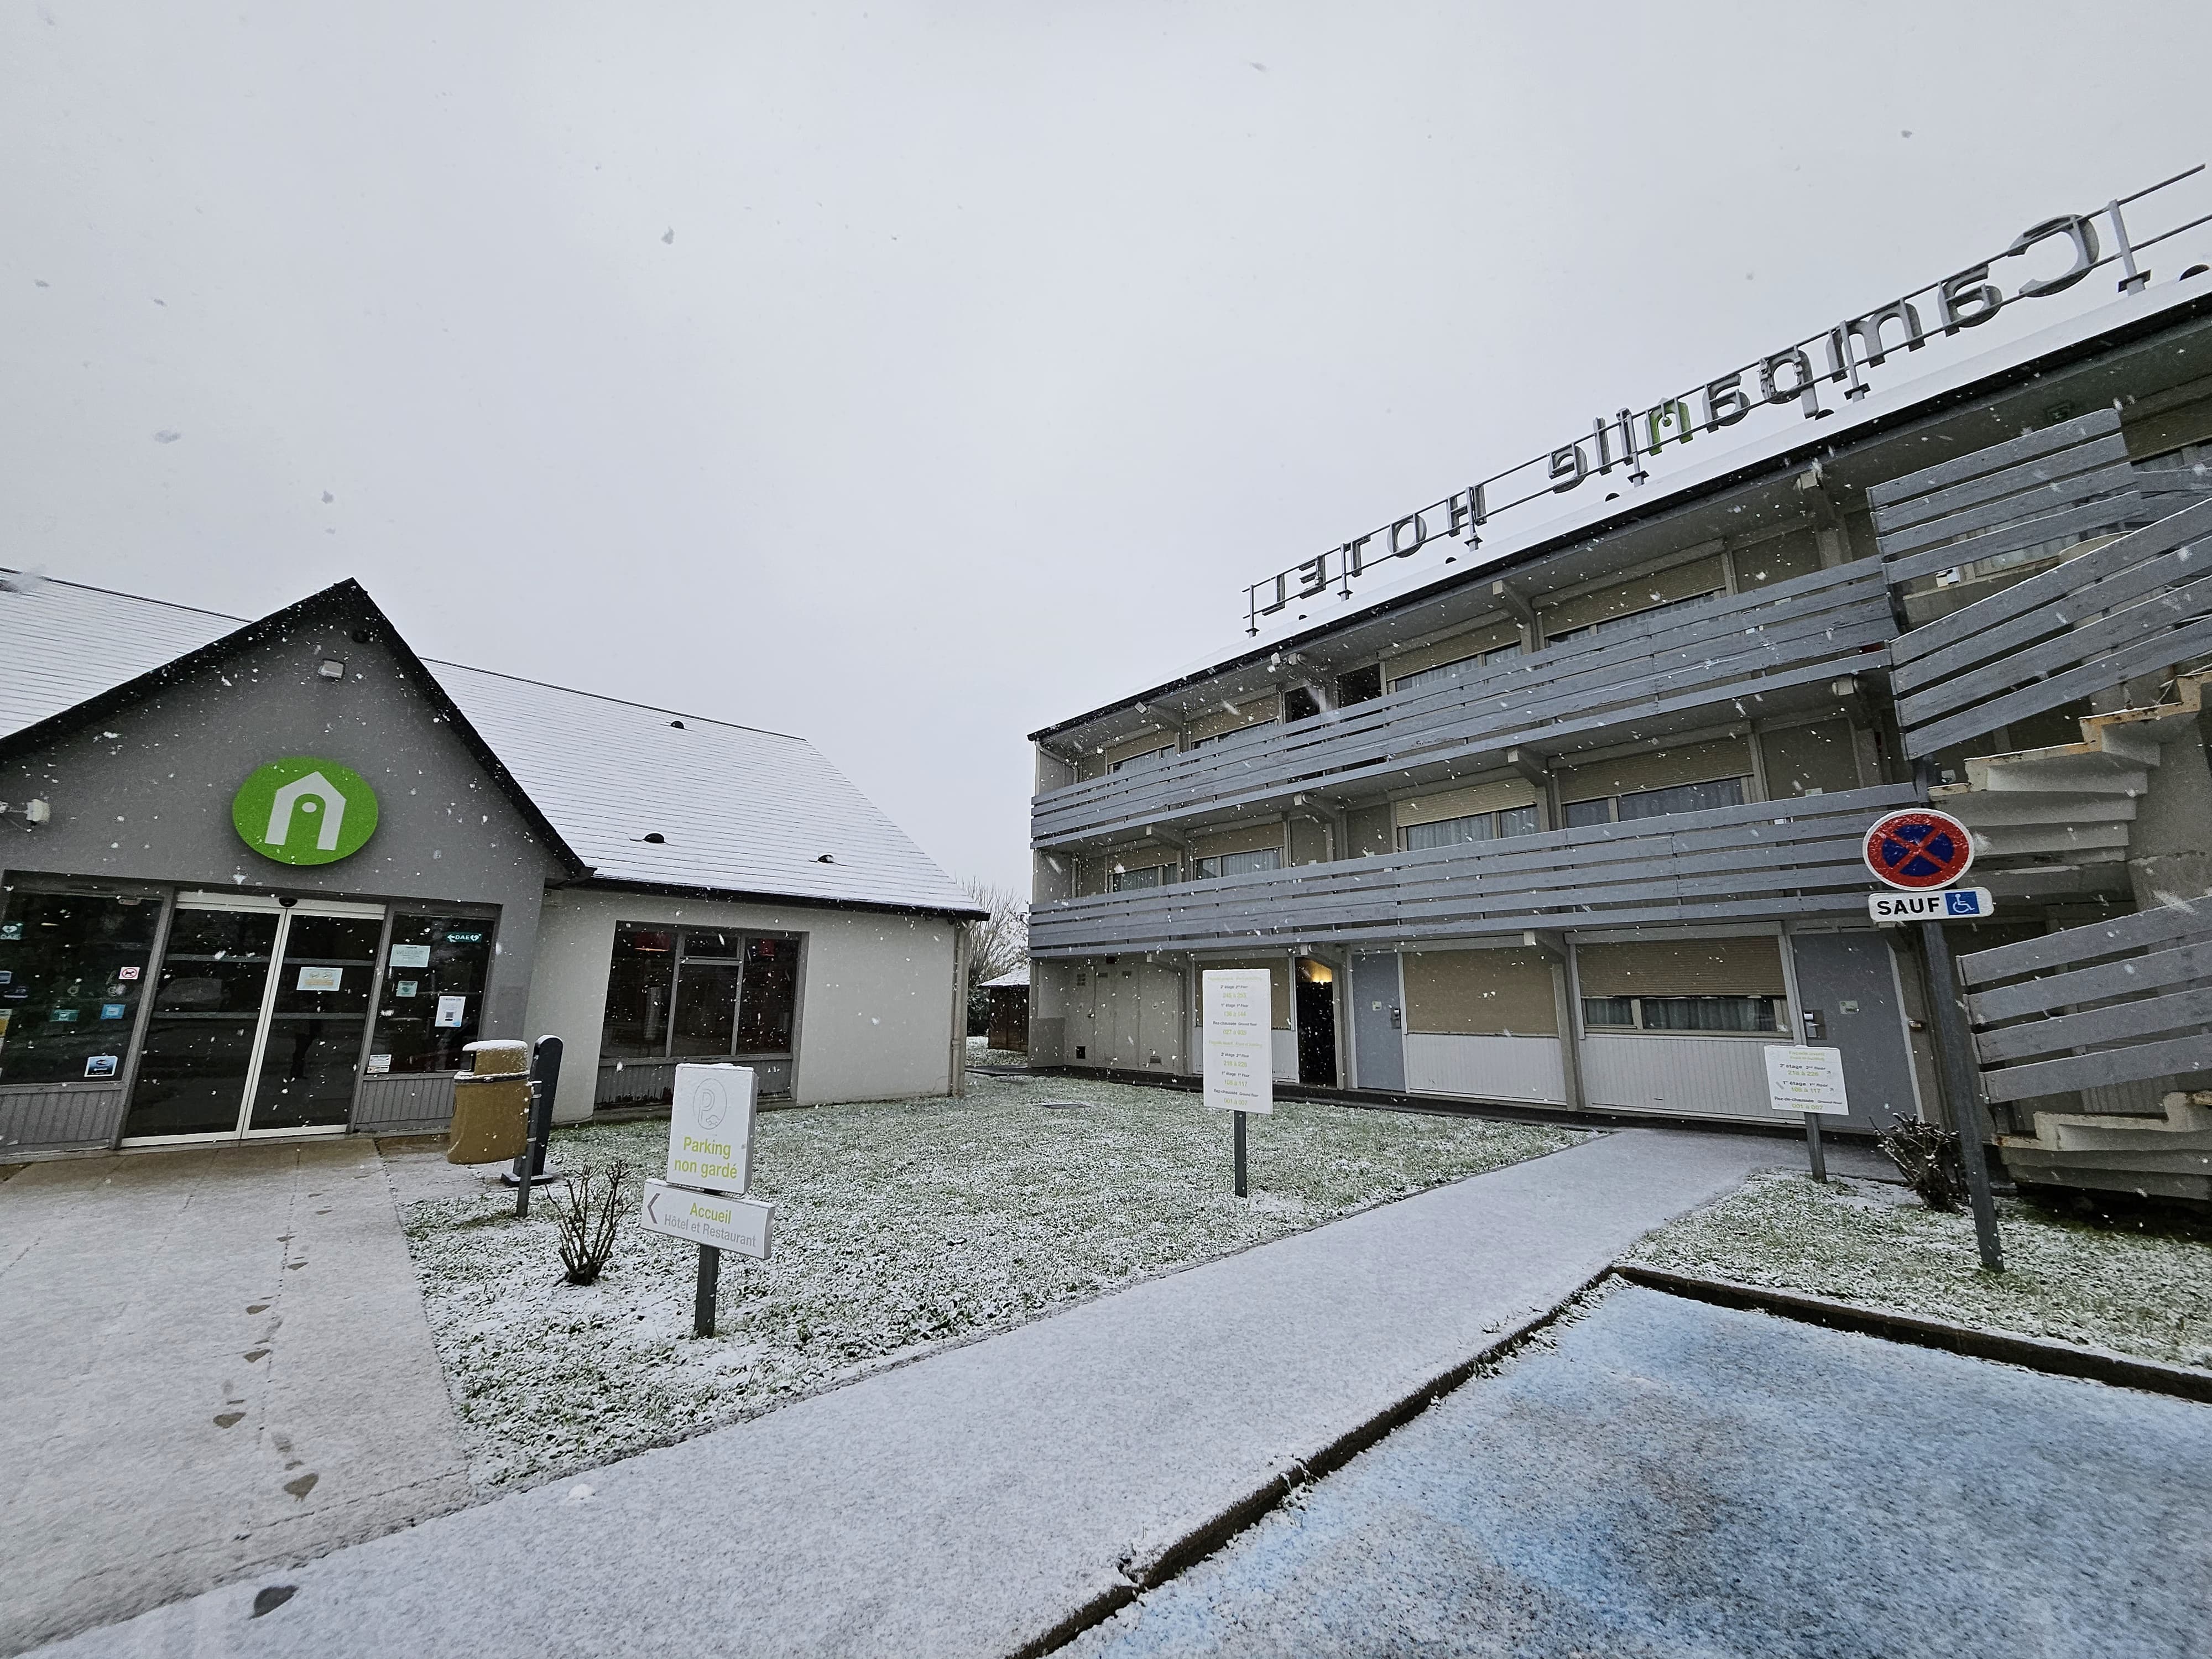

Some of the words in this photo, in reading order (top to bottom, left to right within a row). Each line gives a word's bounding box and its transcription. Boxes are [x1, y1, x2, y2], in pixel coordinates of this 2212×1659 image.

[1877, 897, 1940, 915] SAUF
[684, 1136, 731, 1160] Parking
[675, 1160, 697, 1172] non
[701, 1163, 737, 1178] gardé
[690, 1202, 732, 1224] Accueil
[664, 1214, 688, 1230] Hôtel
[691, 1223, 700, 1235] et
[703, 1223, 757, 1248] Restaurant
